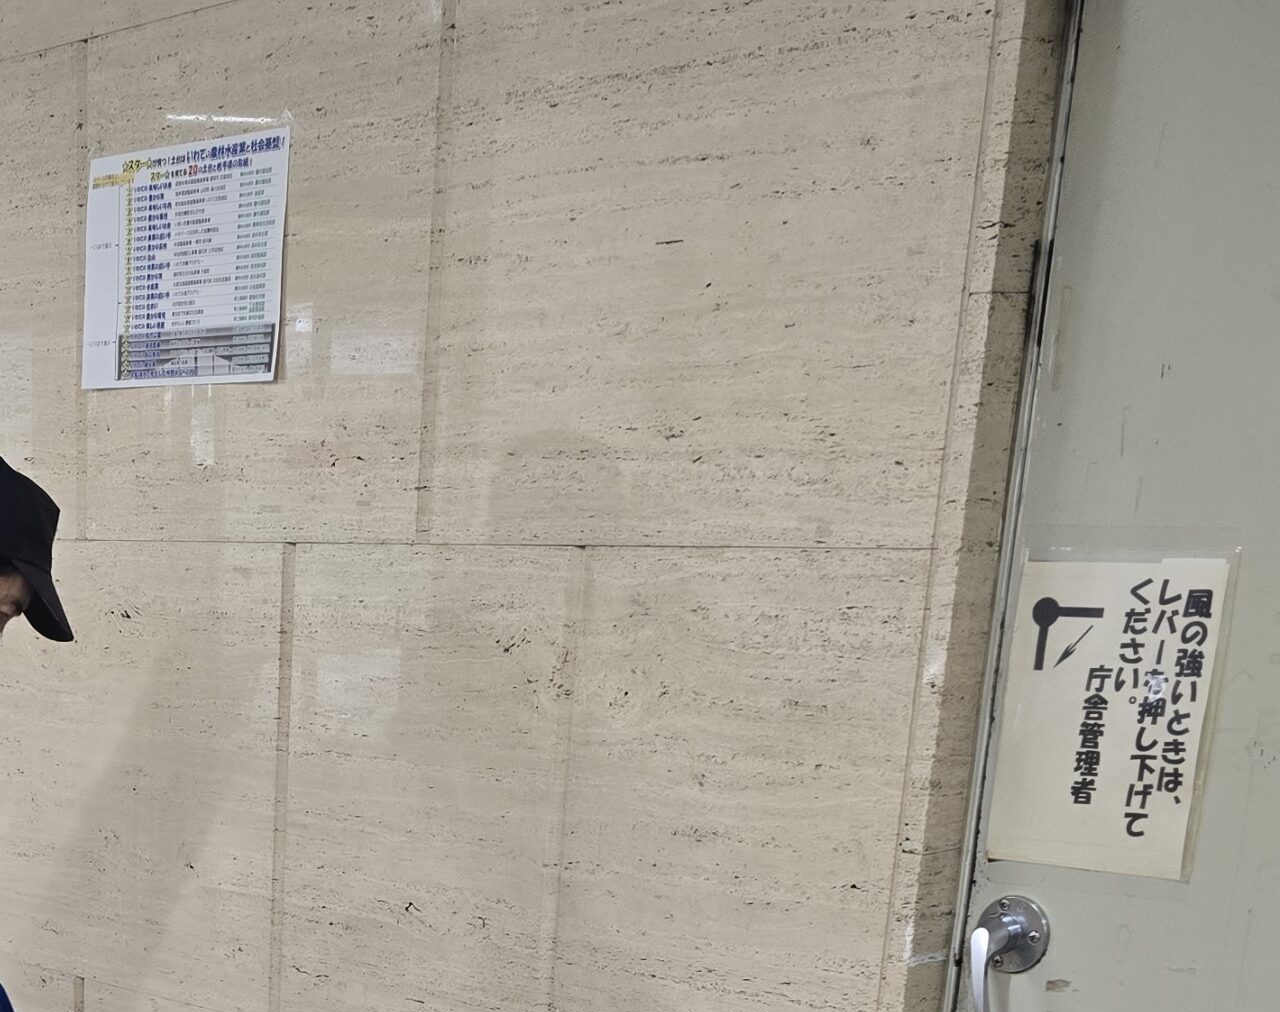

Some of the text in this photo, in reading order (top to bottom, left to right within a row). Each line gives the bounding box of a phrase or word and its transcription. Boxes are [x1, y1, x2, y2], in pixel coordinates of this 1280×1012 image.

[1114, 578, 1153, 705] ください。
[1157, 589, 1213, 805] 風の強いときは、
[1070, 665, 1113, 805] 庁舎管理者
